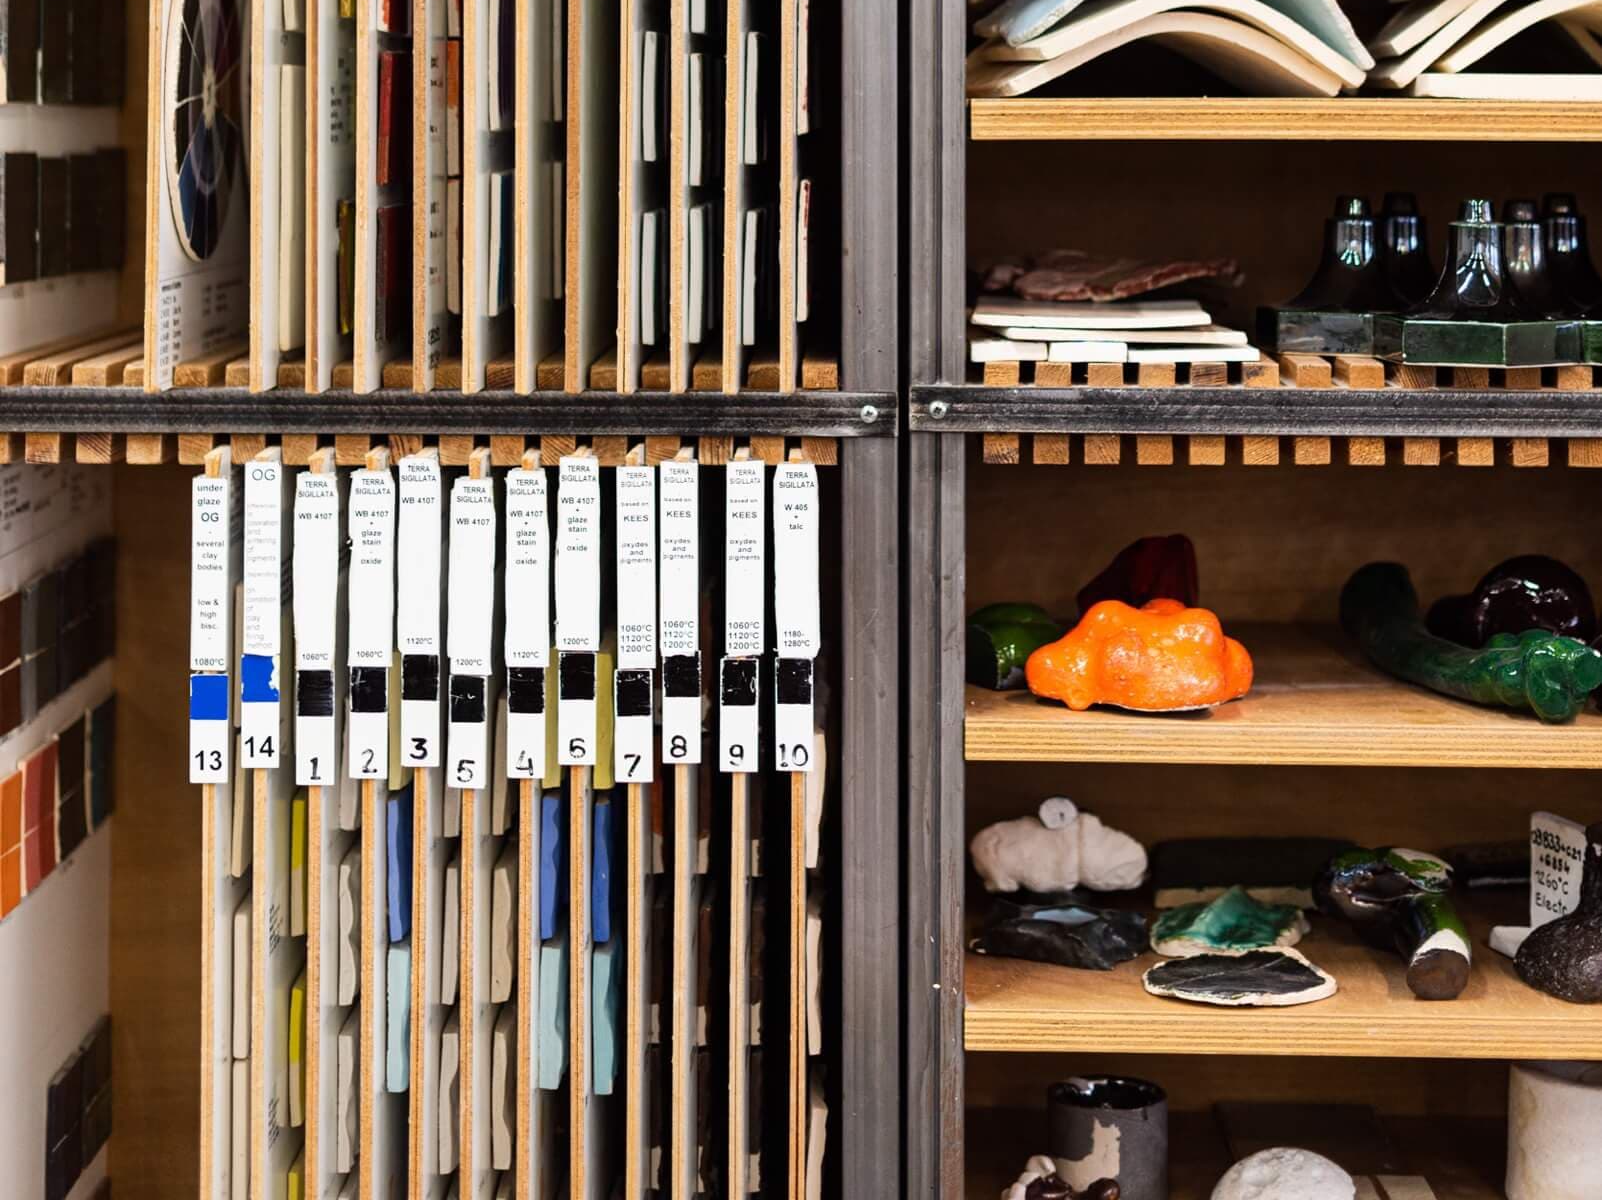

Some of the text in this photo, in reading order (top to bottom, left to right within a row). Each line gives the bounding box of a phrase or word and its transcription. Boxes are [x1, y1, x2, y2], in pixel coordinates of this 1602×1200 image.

[407, 464, 431, 473] TERRA
[567, 464, 591, 473] TERRA
[252, 469, 275, 481] OG
[785, 471, 809, 479] TERRA
[304, 480, 328, 489] TERRA
[361, 478, 385, 486] TERRA
[515, 478, 539, 487] TERRA
[196, 483, 224, 492] under
[463, 485, 487, 494] TERRA
[197, 497, 221, 507] glaze
[401, 496, 435, 505] WB 4107
[560, 496, 575, 505] WB
[784, 503, 793, 511] W
[201, 512, 219, 522] OG
[298, 512, 333, 520] WB 4107
[354, 510, 389, 518] WB 4107
[509, 510, 544, 518] WB 4107
[623, 514, 649, 523] KEES
[666, 510, 692, 519] KEES
[731, 511, 758, 519] KEES
[455, 517, 491, 526] WB 4107
[567, 515, 588, 525] glaze
[361, 529, 382, 538] glaze
[567, 525, 588, 533] stain
[515, 529, 537, 539] glaze
[196, 540, 225, 548] several
[516, 539, 537, 547] stain
[566, 544, 588, 552] oxide
[201, 551, 218, 561] clay
[196, 563, 224, 571] bodies
[199, 610, 217, 620] high
[620, 624, 653, 633] 1060°C
[663, 620, 695, 629] 1060°C
[728, 621, 760, 630] 1060°C
[245, 736, 274, 757] 14
[410, 738, 427, 760] 3
[570, 738, 585, 758] 6
[670, 735, 687, 758] 8
[730, 744, 744, 765] 9
[779, 744, 808, 767] 10
[195, 751, 222, 770] 13
[362, 749, 377, 773] 2
[516, 751, 533, 776] 4
[310, 757, 320, 780] 1
[624, 754, 641, 777] 7
[457, 760, 475, 782] 5
